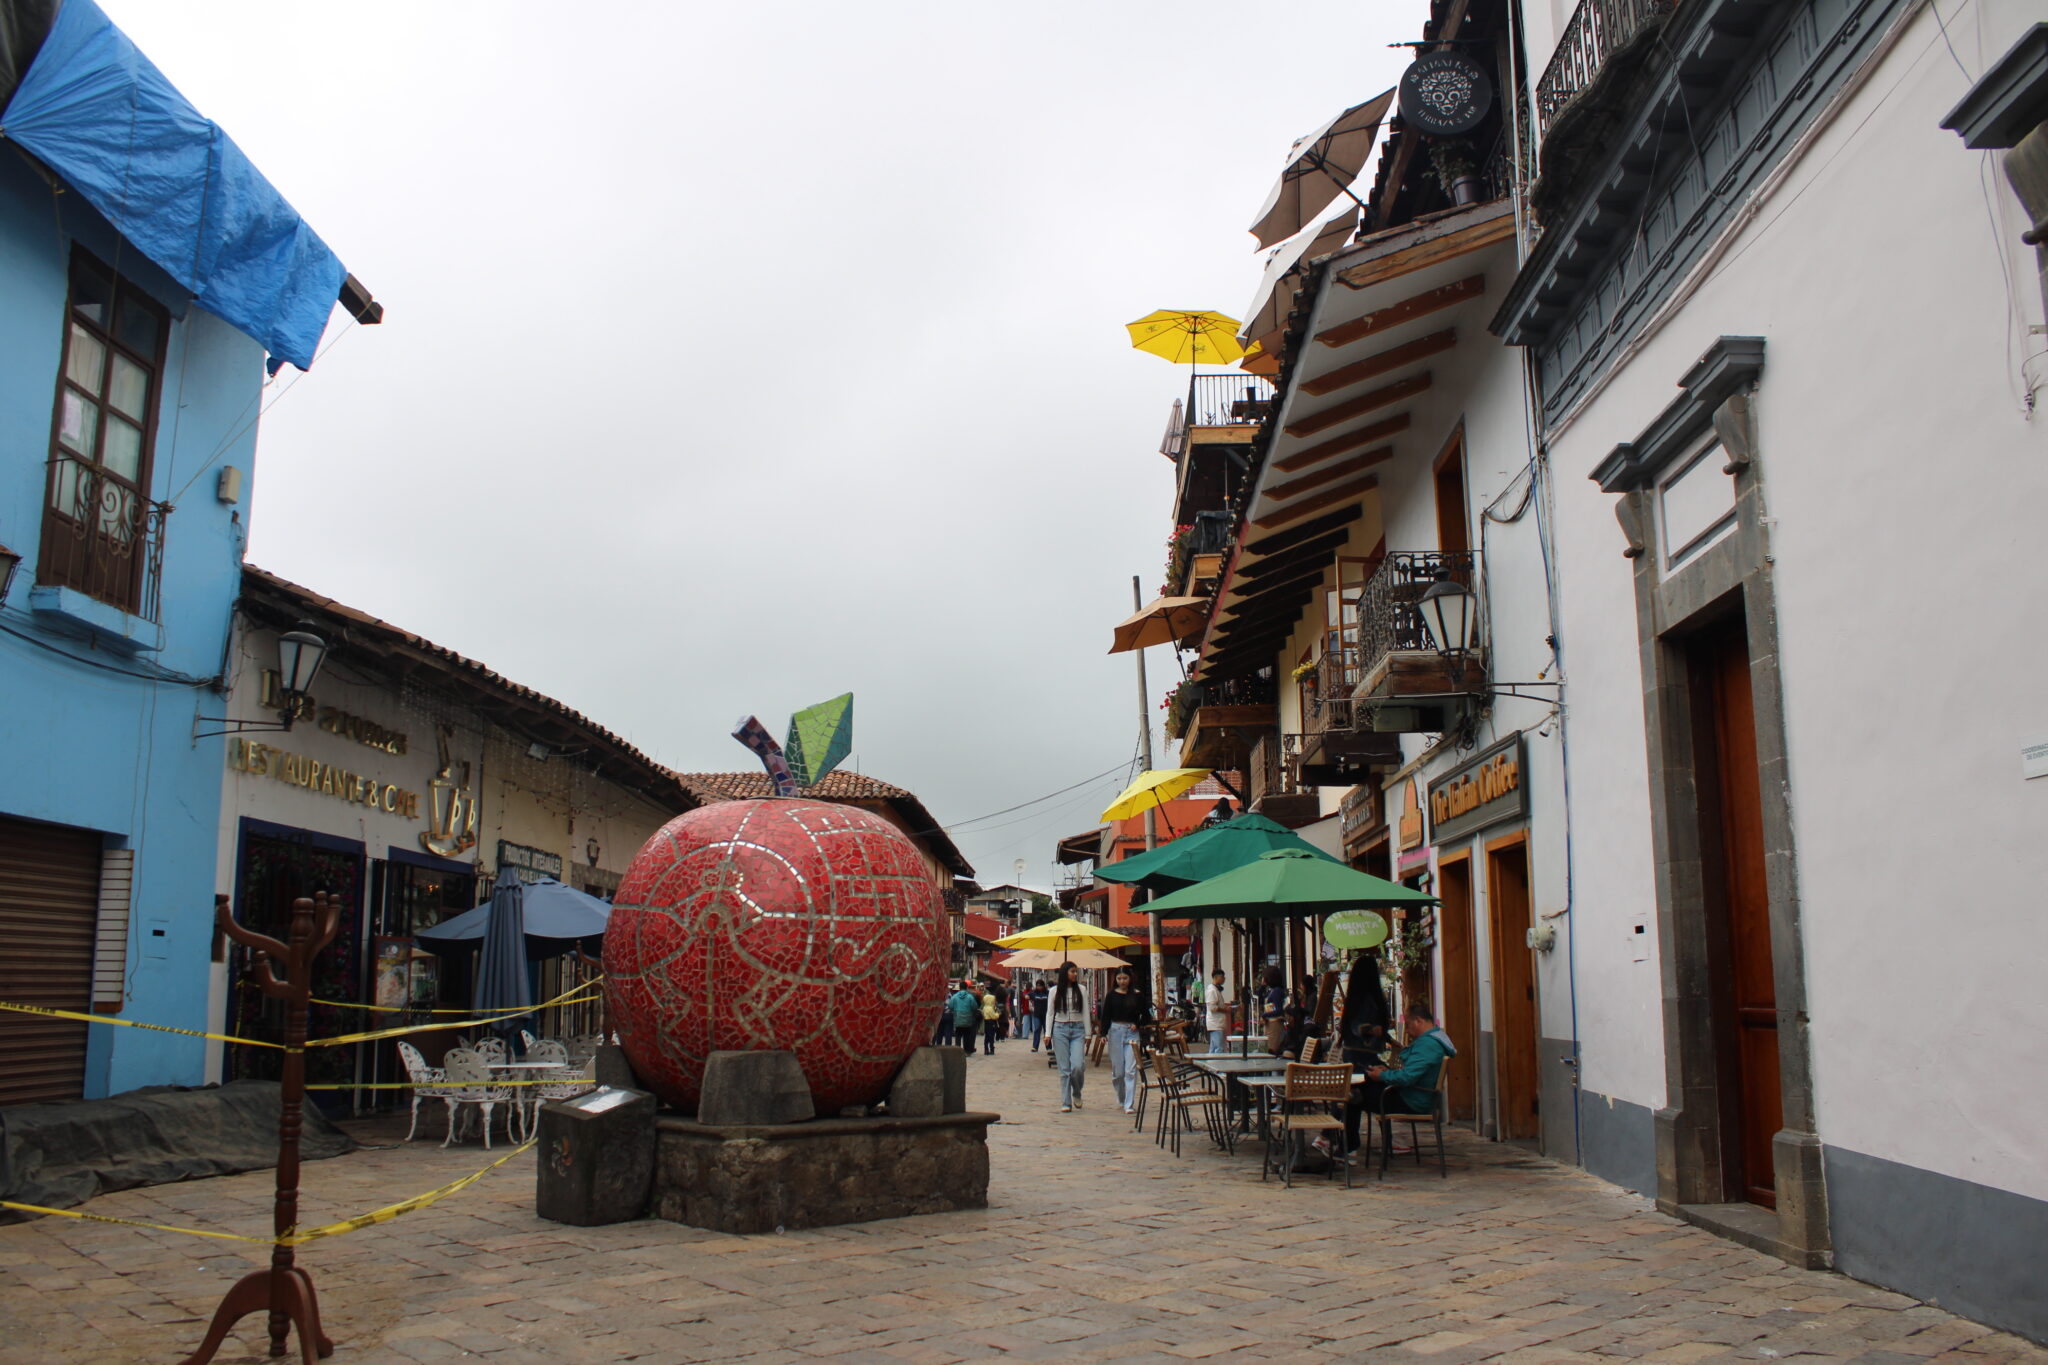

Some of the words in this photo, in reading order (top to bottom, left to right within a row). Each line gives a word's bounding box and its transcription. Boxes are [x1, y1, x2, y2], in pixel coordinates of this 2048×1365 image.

[1418, 109, 1454, 127] TERRAZA
[229, 737, 364, 804] RESTAURANTE
[366, 779, 380, 808] &
[382, 784, 422, 819] CAFE
[1432, 790, 1449, 825] The
[1448, 773, 1479, 818] Italian
[1479, 753, 1518, 803] Coffee
